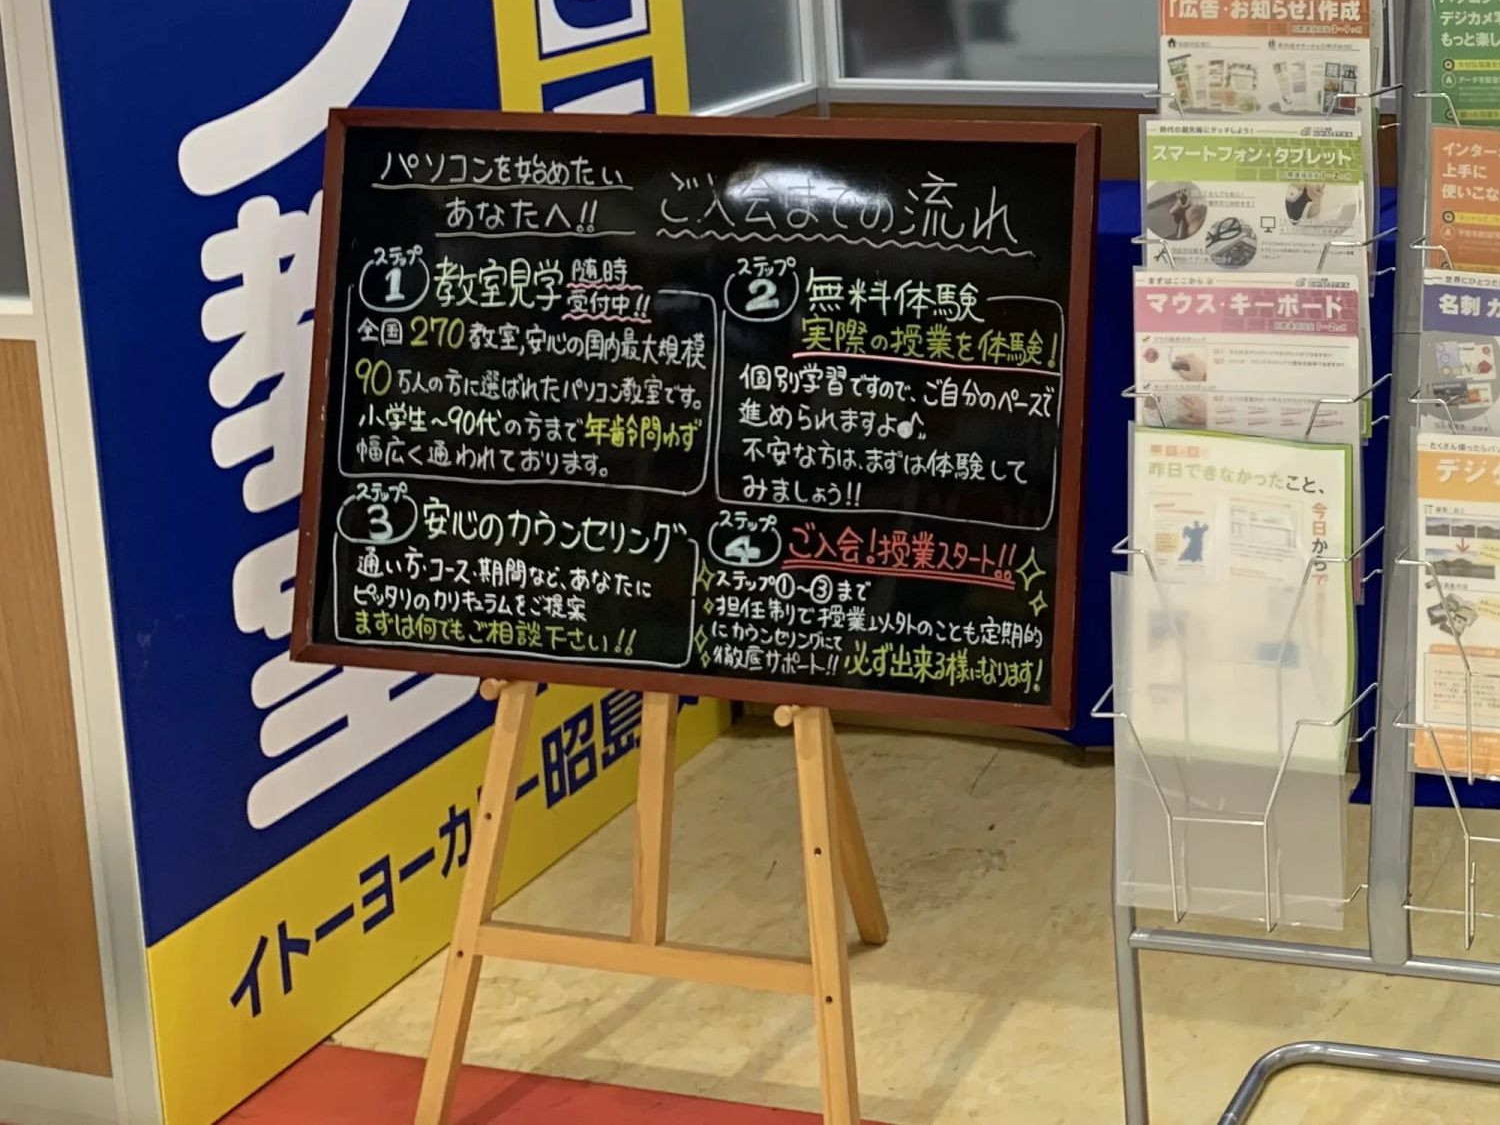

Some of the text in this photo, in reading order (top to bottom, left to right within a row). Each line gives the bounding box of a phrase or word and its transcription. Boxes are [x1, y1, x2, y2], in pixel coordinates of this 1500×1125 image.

[379, 151, 624, 186] パソコンを始めたい
[1151, 145, 1353, 167] スマートフォン・タブレット
[1442, 163, 1488, 179] 上手に
[445, 196, 598, 233] あなたへ!!
[660, 170, 1018, 244] ご入会までの流れ
[374, 244, 424, 267] ステップ
[571, 257, 628, 286] 随時
[737, 256, 797, 277] ステップ
[384, 255, 565, 313] 1 教室見学
[745, 267, 986, 324] 2 無料体験
[566, 289, 652, 318] 受付中!!
[1146, 292, 1343, 319] マウス・キーボード
[1438, 292, 1480, 316] 名刺
[800, 313, 1058, 368] 実際の授業を体験!
[739, 362, 1056, 419] 個別学習ですので、ご自分のペースで
[355, 435, 609, 478] 幅広く通われております。
[741, 436, 1029, 485] 不安な方は、まずは体験して
[356, 481, 408, 503] ステップ
[742, 474, 862, 507] みましょう!!
[1148, 460, 1326, 495] 昨日できなかったこと、
[366, 495, 687, 563] 3 安心のカウンセリング
[719, 509, 778, 532] ステップ
[724, 535, 761, 564] 4
[353, 586, 588, 623] ピッタリのカリキュラムをご提案
[354, 611, 638, 656] まずは何でもご相談下さい!!
[711, 620, 844, 652] にカウンセリングにて
[712, 640, 1044, 693] 徹底サポート!! 必ず出来る様になります!
[230, 681, 701, 1018] イトーヨーカー昭島
